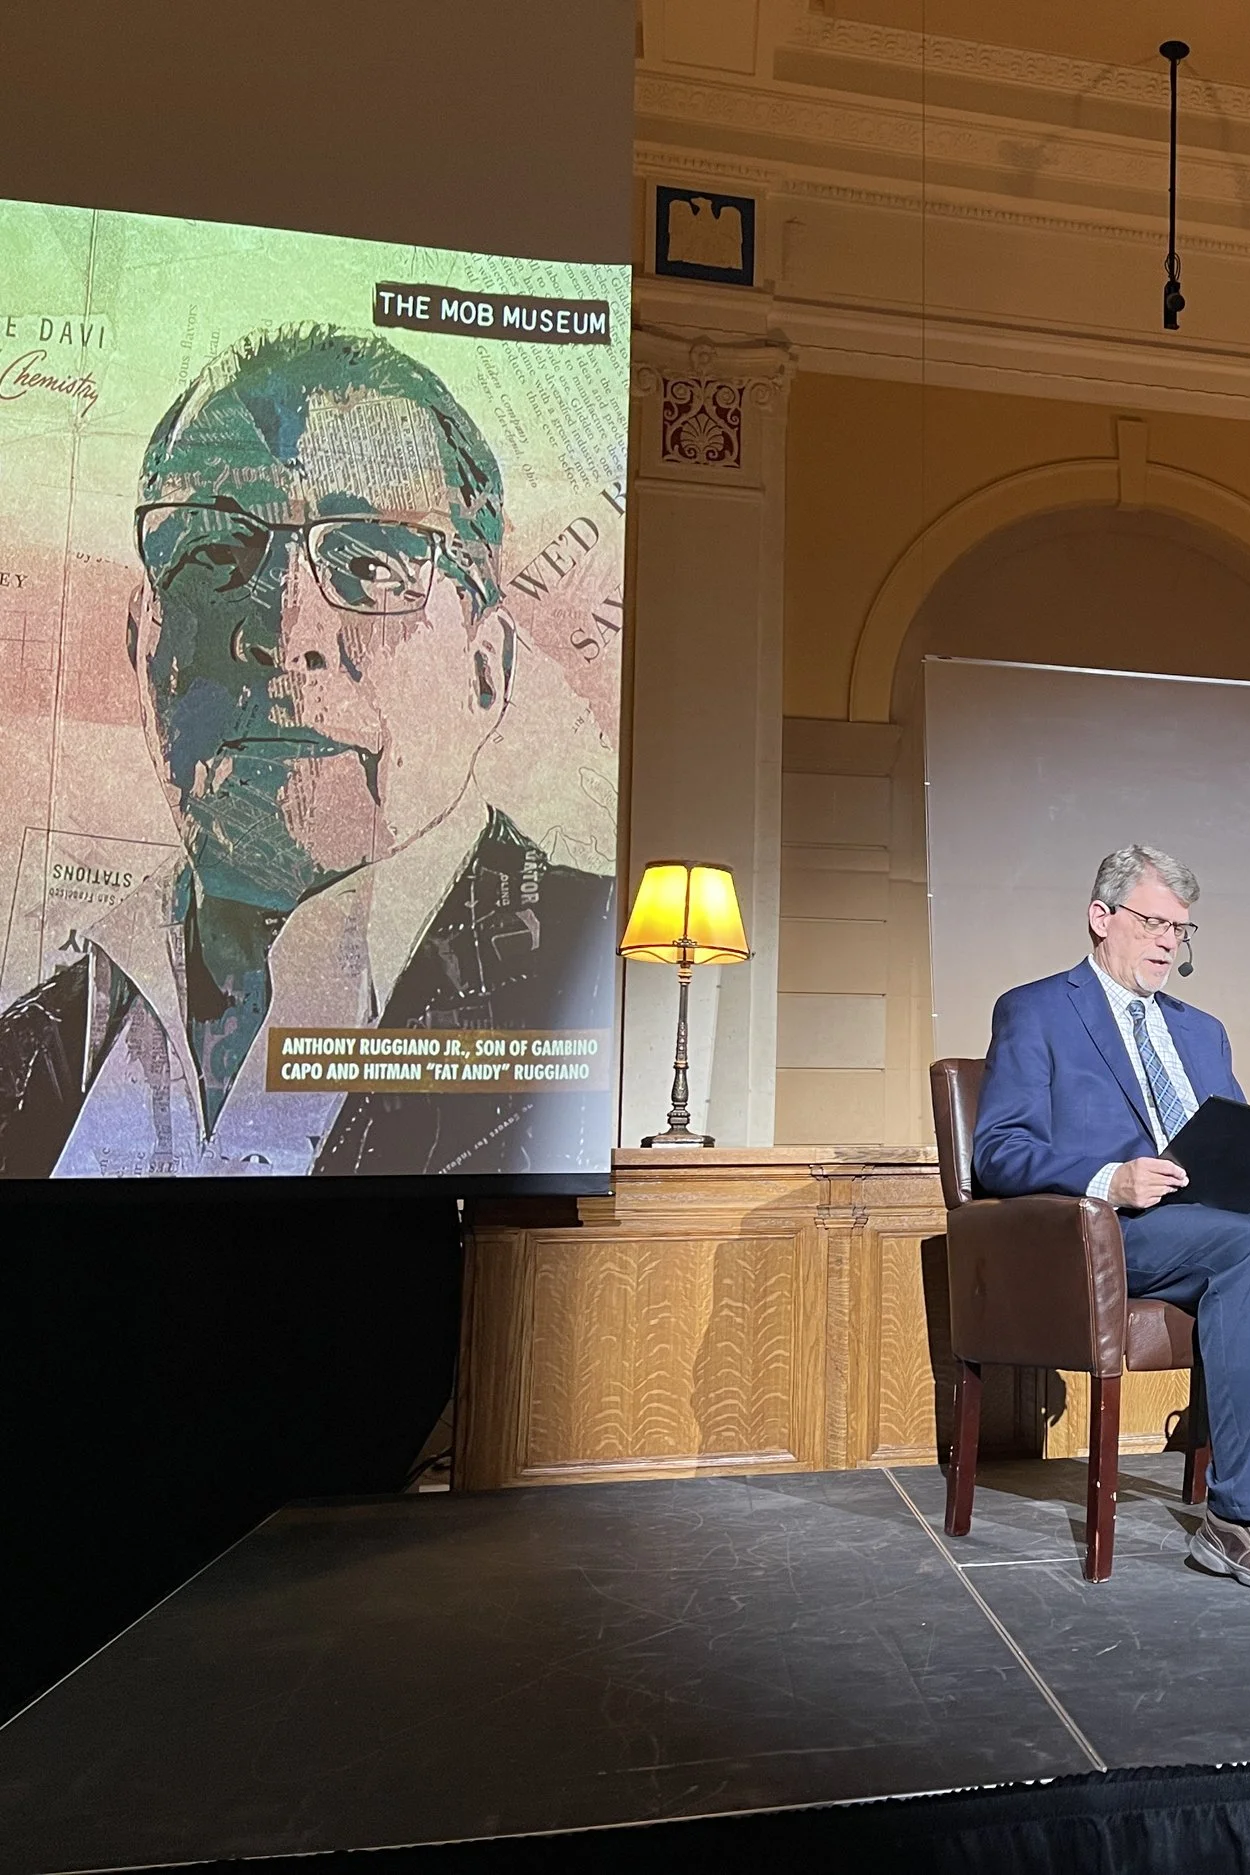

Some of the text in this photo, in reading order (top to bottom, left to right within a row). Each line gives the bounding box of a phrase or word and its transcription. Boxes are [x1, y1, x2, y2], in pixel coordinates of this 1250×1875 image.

[379, 291, 606, 335] THE MOB MUSEUM
[39, 318, 104, 348] DAVI
[0, 349, 99, 418] Chemistry
[533, 378, 551, 403] with
[600, 377, 613, 393] the
[526, 390, 544, 416] than
[570, 397, 596, 439] Glidden
[53, 864, 132, 887] STATIONS
[281, 1037, 598, 1059] ANTHONY RUGGIANO JR., SON OF GAMBINO
[281, 1062, 322, 1080] CAPO
[326, 1062, 359, 1080] AND
[363, 1062, 421, 1080] HITMAN
[514, 1063, 589, 1080] RUGGIANO
